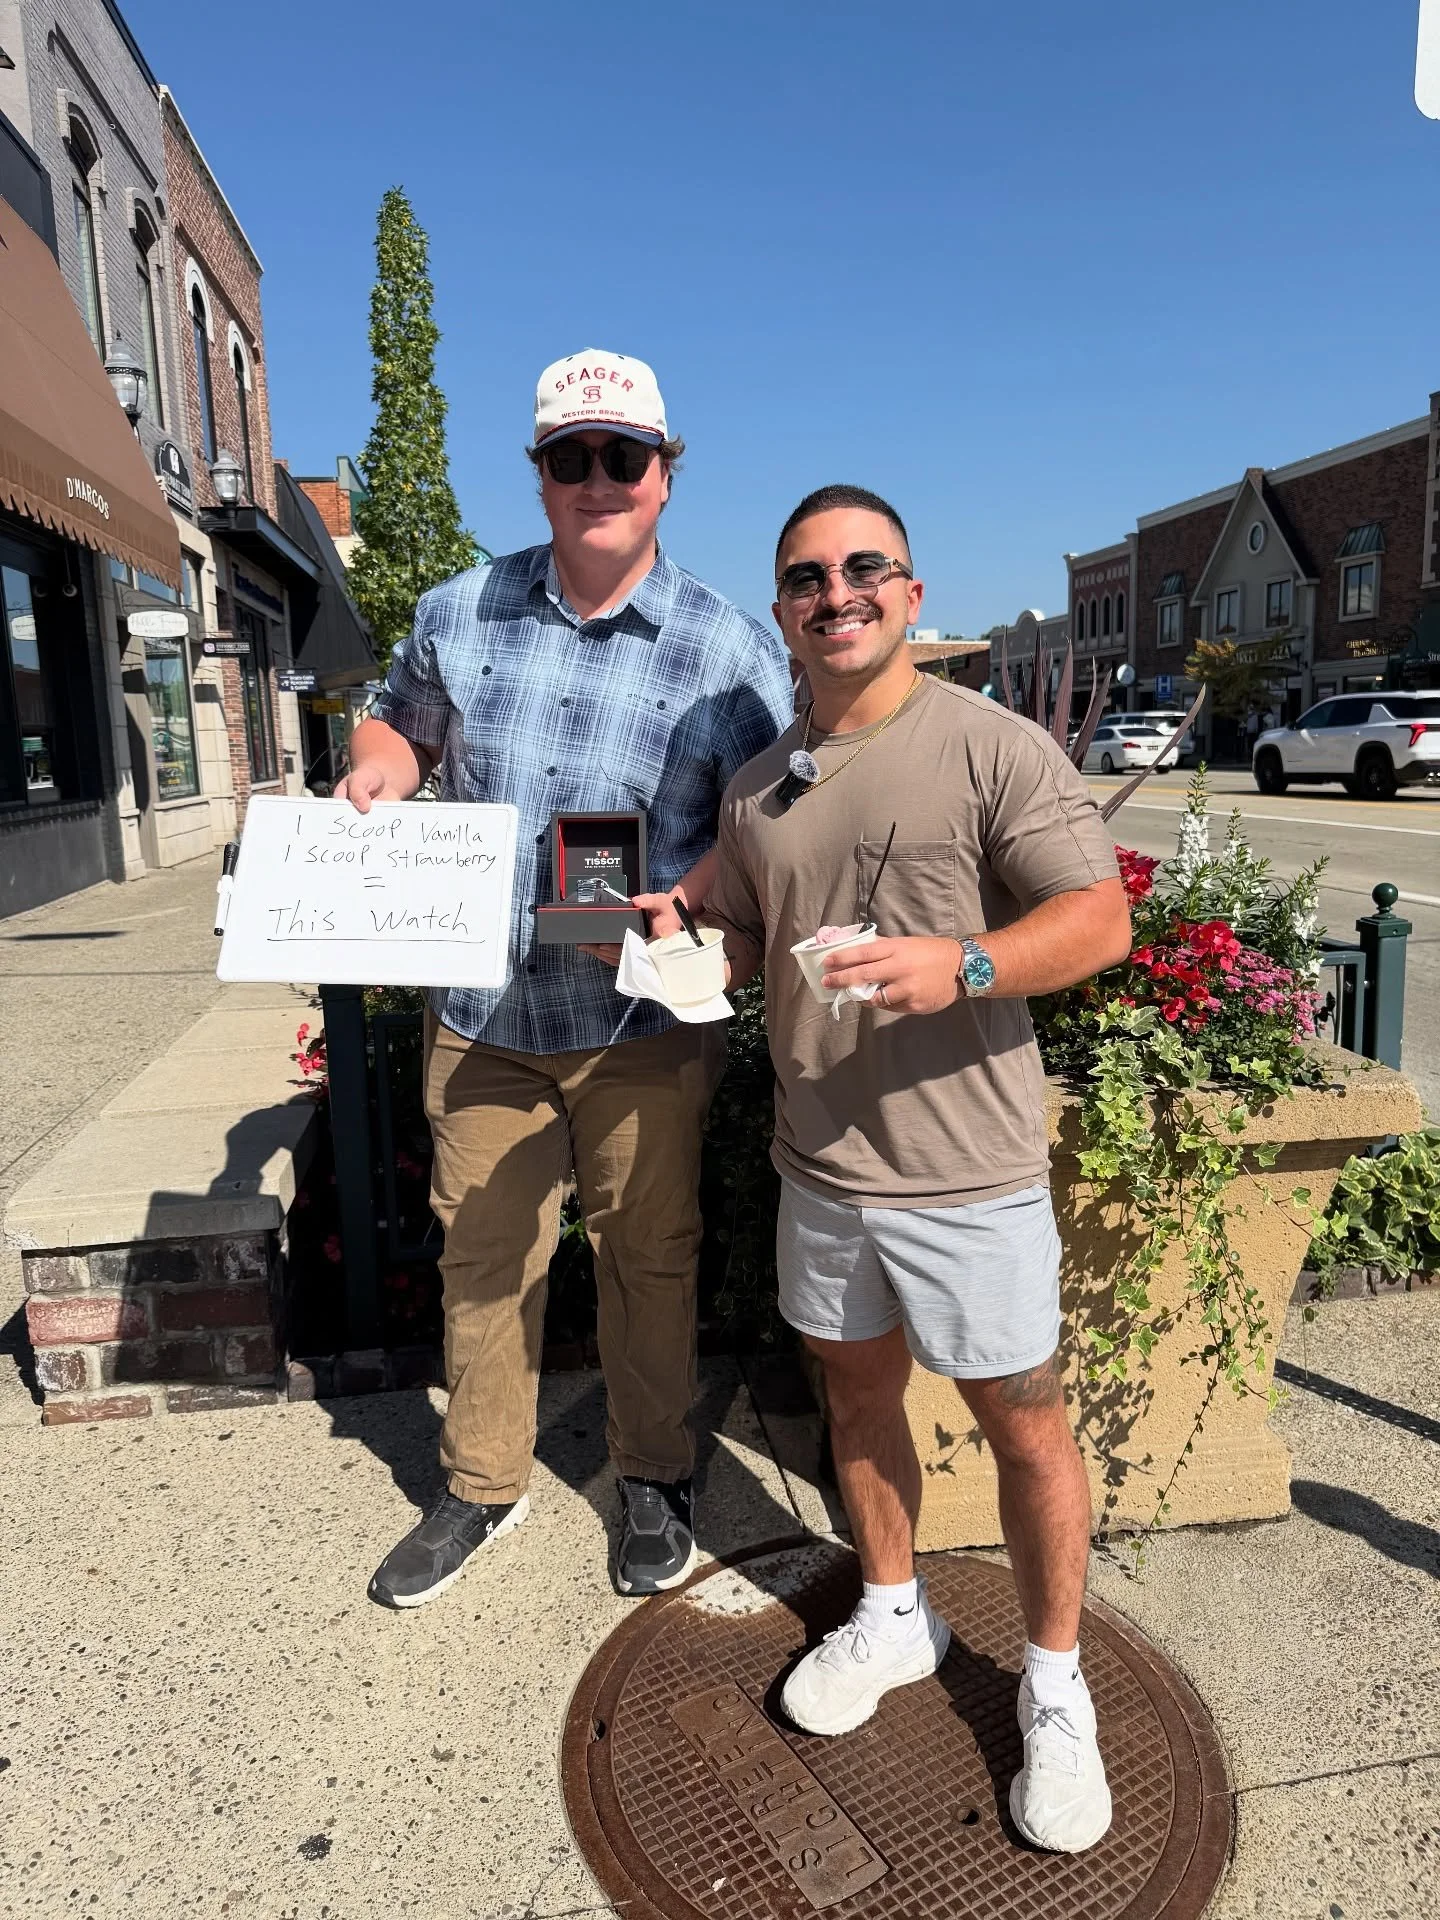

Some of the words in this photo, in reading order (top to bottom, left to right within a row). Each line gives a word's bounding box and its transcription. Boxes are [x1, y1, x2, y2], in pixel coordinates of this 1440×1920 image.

[555, 367, 635, 393] SEAGER
[561, 409, 596, 419] WESTERN
[598, 409, 625, 418] BRAND
[66, 477, 110, 520] D'MARCOS
[1158, 676, 1170, 692] H
[296, 814, 301, 835] 1
[421, 815, 483, 847] Vanilla
[284, 844, 291, 863] 1
[584, 857, 621, 866] TISSOT
[268, 899, 335, 934] This
[370, 901, 469, 935] Watch
[712, 1692, 874, 1880] LIGHTING
[693, 1732, 822, 1873] STREET
